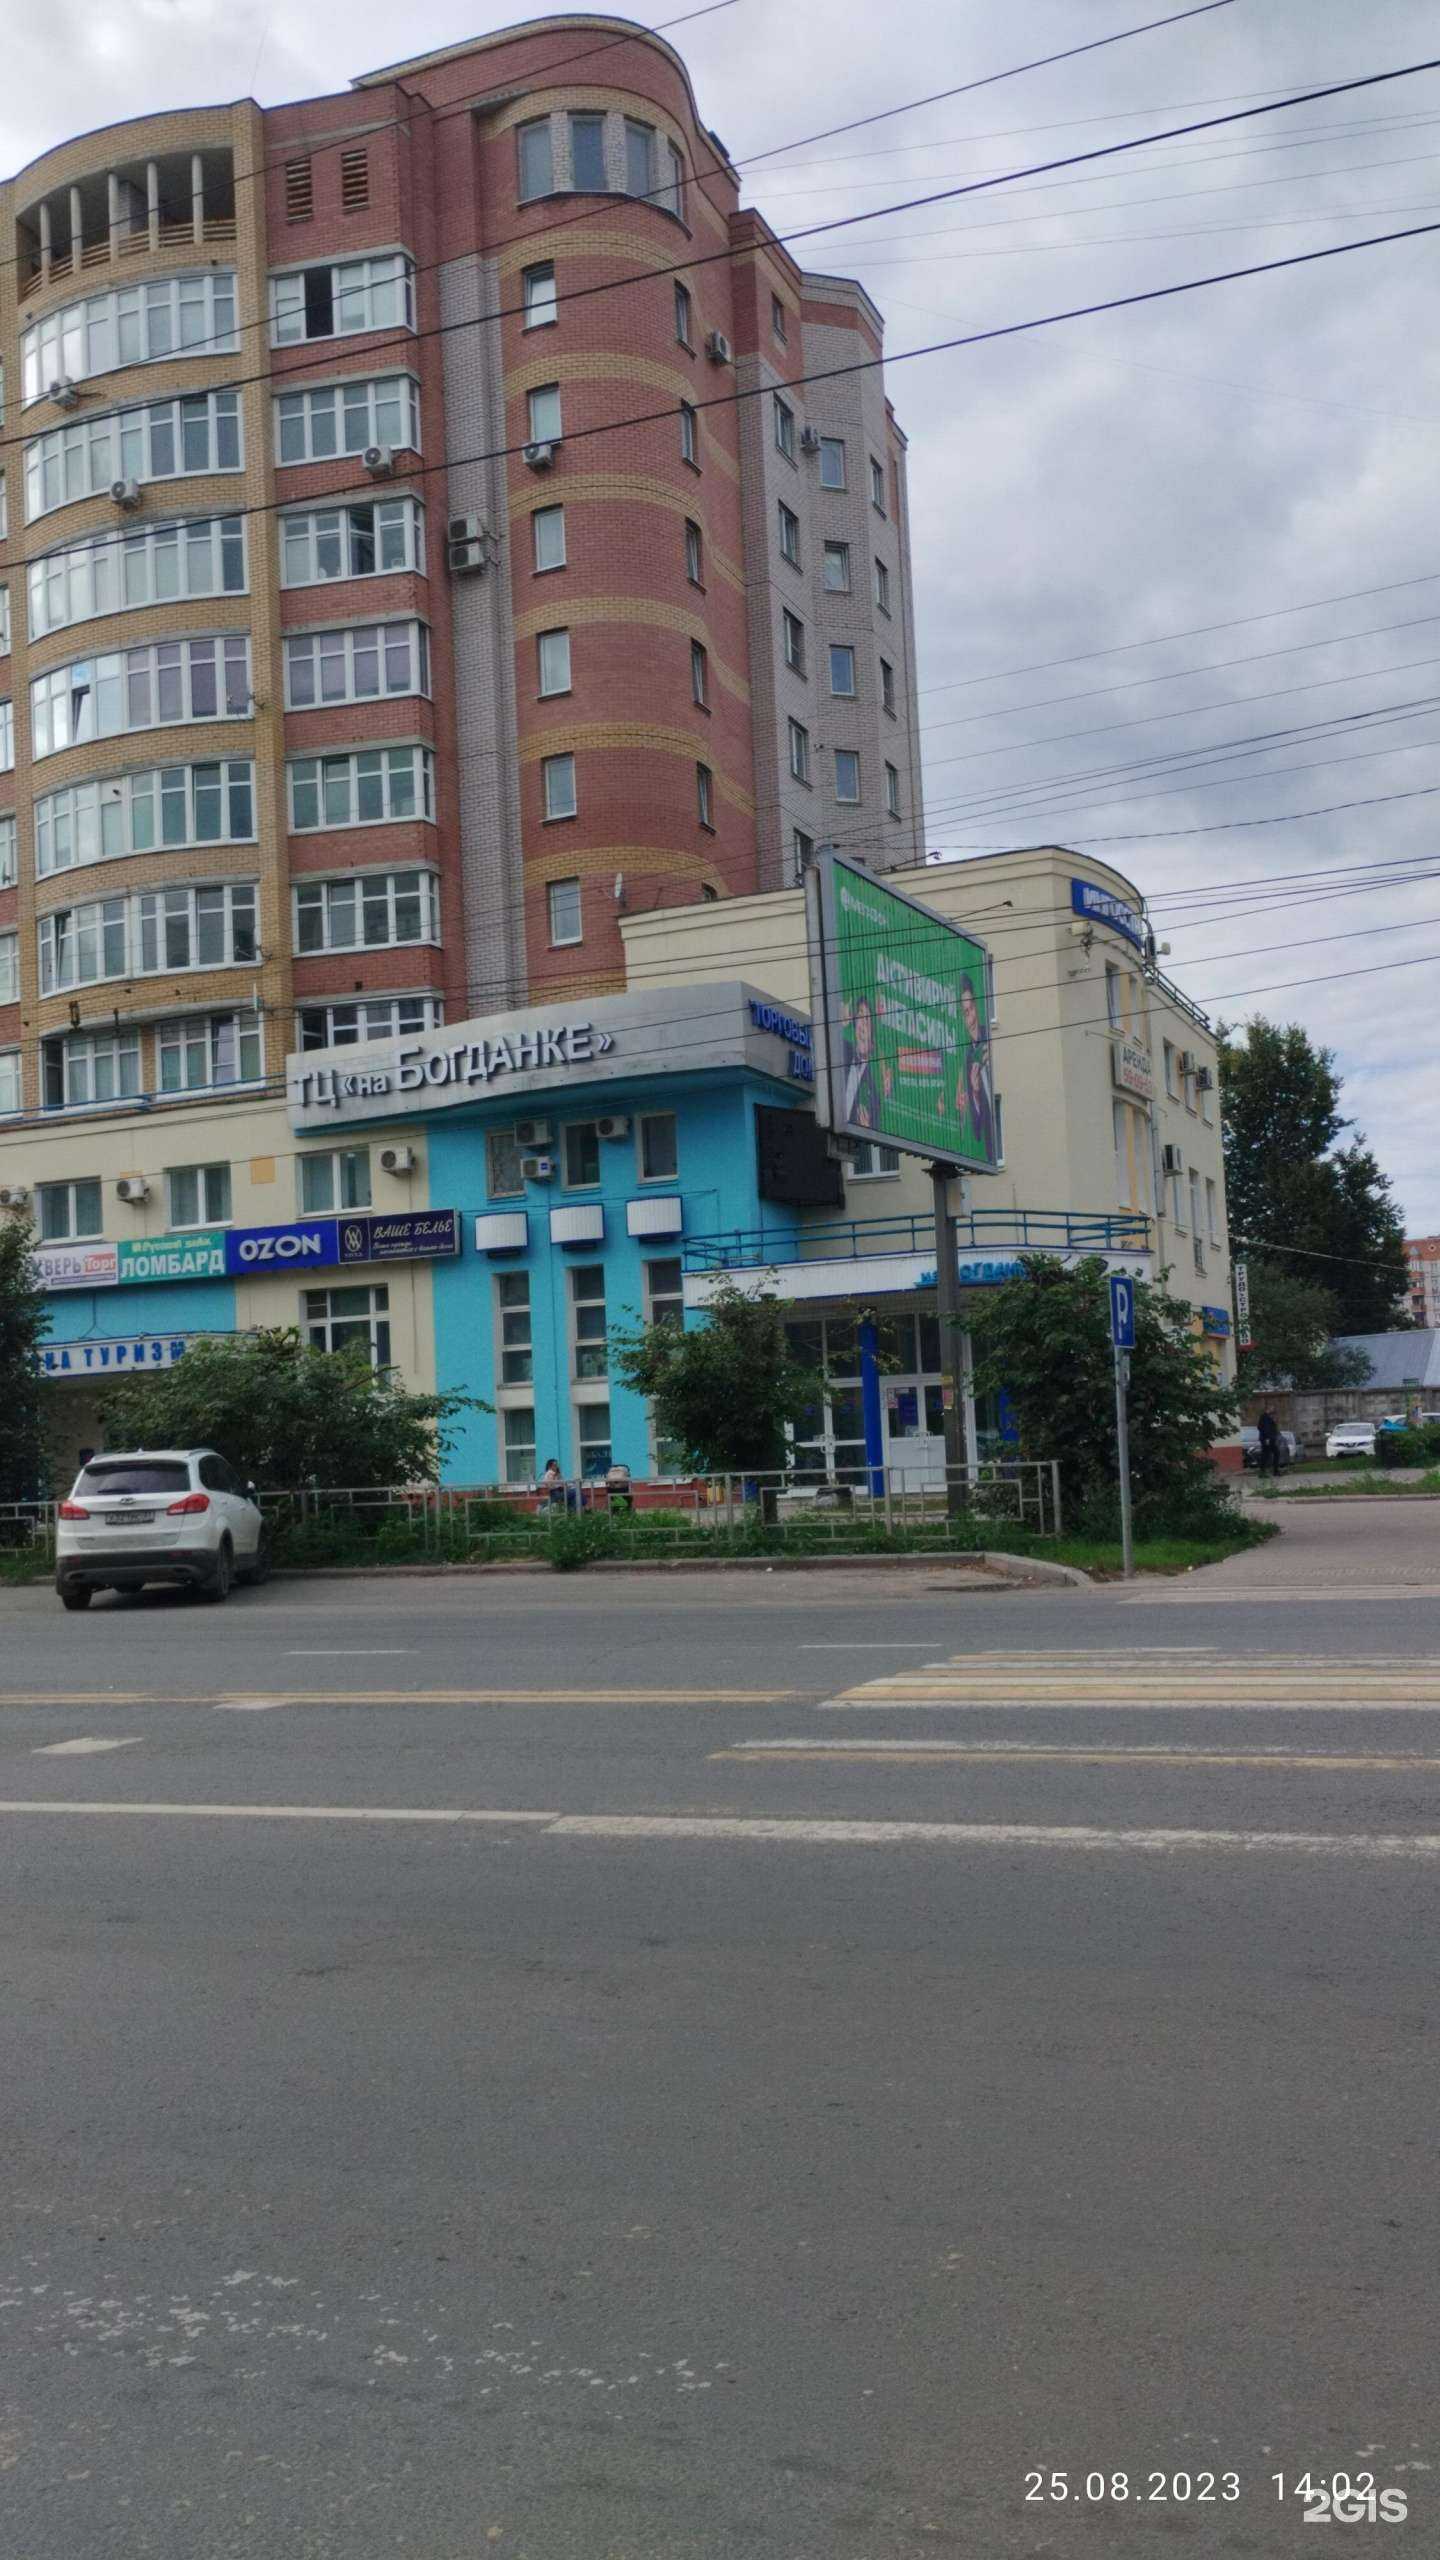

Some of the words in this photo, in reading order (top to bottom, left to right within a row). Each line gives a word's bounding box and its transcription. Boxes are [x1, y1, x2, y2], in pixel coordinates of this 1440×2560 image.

[749, 1000, 812, 1049] ТОРГОВЫ
[295, 1069, 339, 1107] ТЦ
[373, 1223, 411, 1239] ВАШЕ
[239, 1234, 321, 1261] OZON
[120, 1249, 225, 1278] ЛОМБАРД
